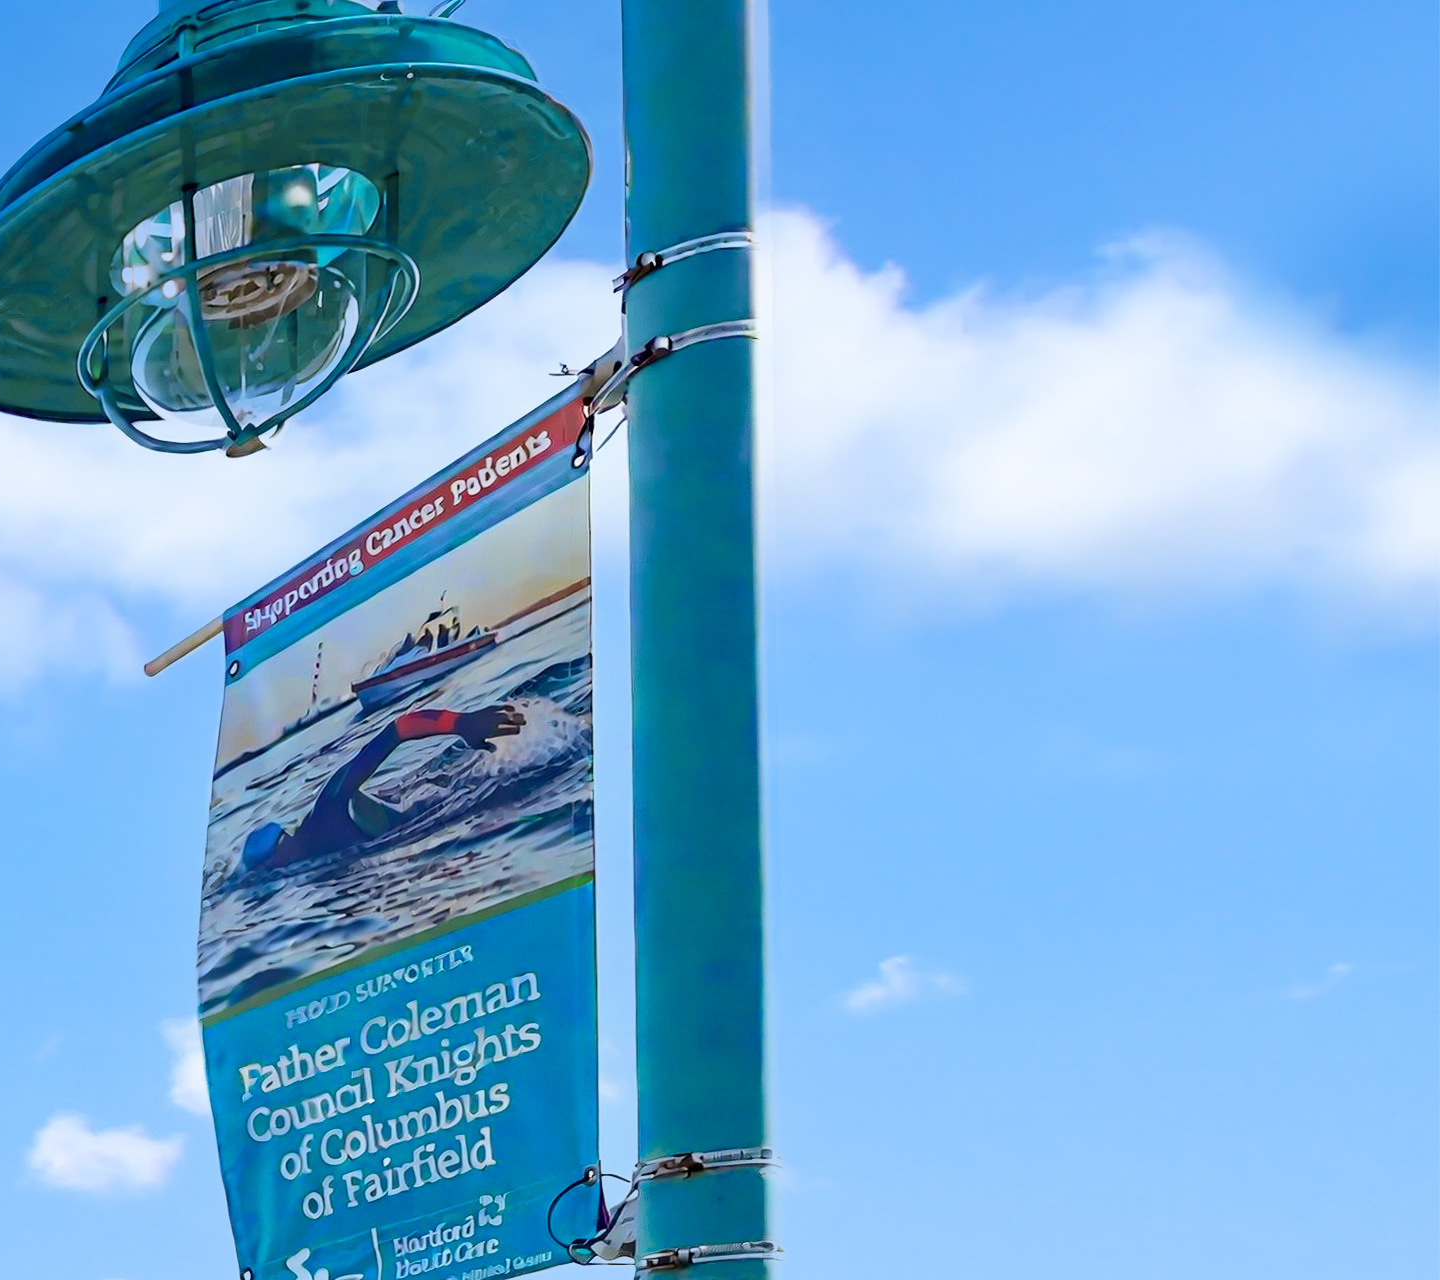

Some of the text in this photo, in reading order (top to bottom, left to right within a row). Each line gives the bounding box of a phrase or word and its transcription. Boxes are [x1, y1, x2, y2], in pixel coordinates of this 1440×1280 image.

[365, 494, 445, 556] Cancer
[239, 971, 541, 1102] Father Coleman
[247, 1020, 542, 1142] Council Knights
[280, 1082, 511, 1181] of Columbus
[302, 1128, 496, 1220] of Fairfield
